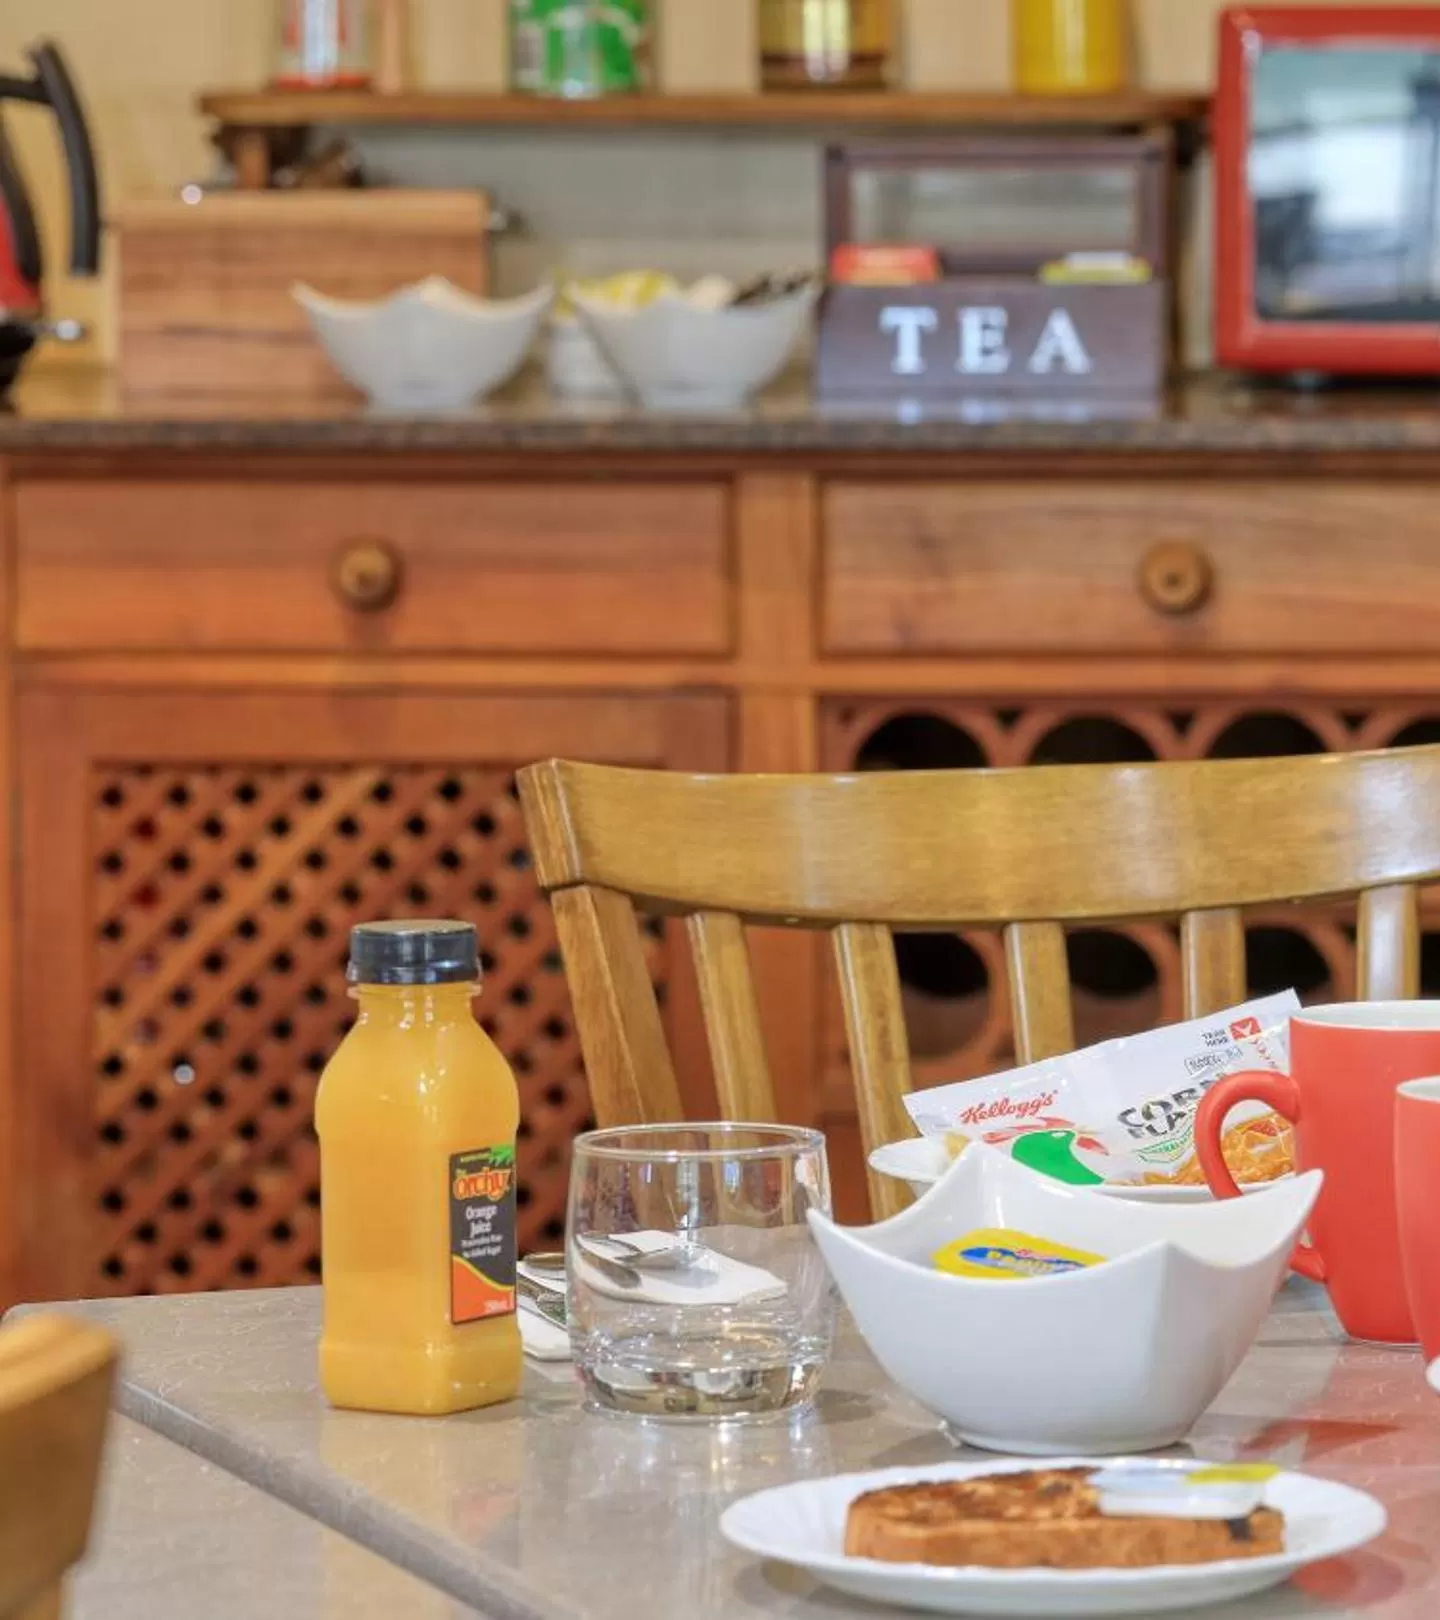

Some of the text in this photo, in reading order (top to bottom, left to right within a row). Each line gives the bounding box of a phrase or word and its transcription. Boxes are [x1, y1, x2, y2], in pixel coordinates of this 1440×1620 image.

[879, 305, 1094, 375] TEA
[960, 1091, 1054, 1124] Kellogg's
[1117, 1074, 1222, 1128] COR
